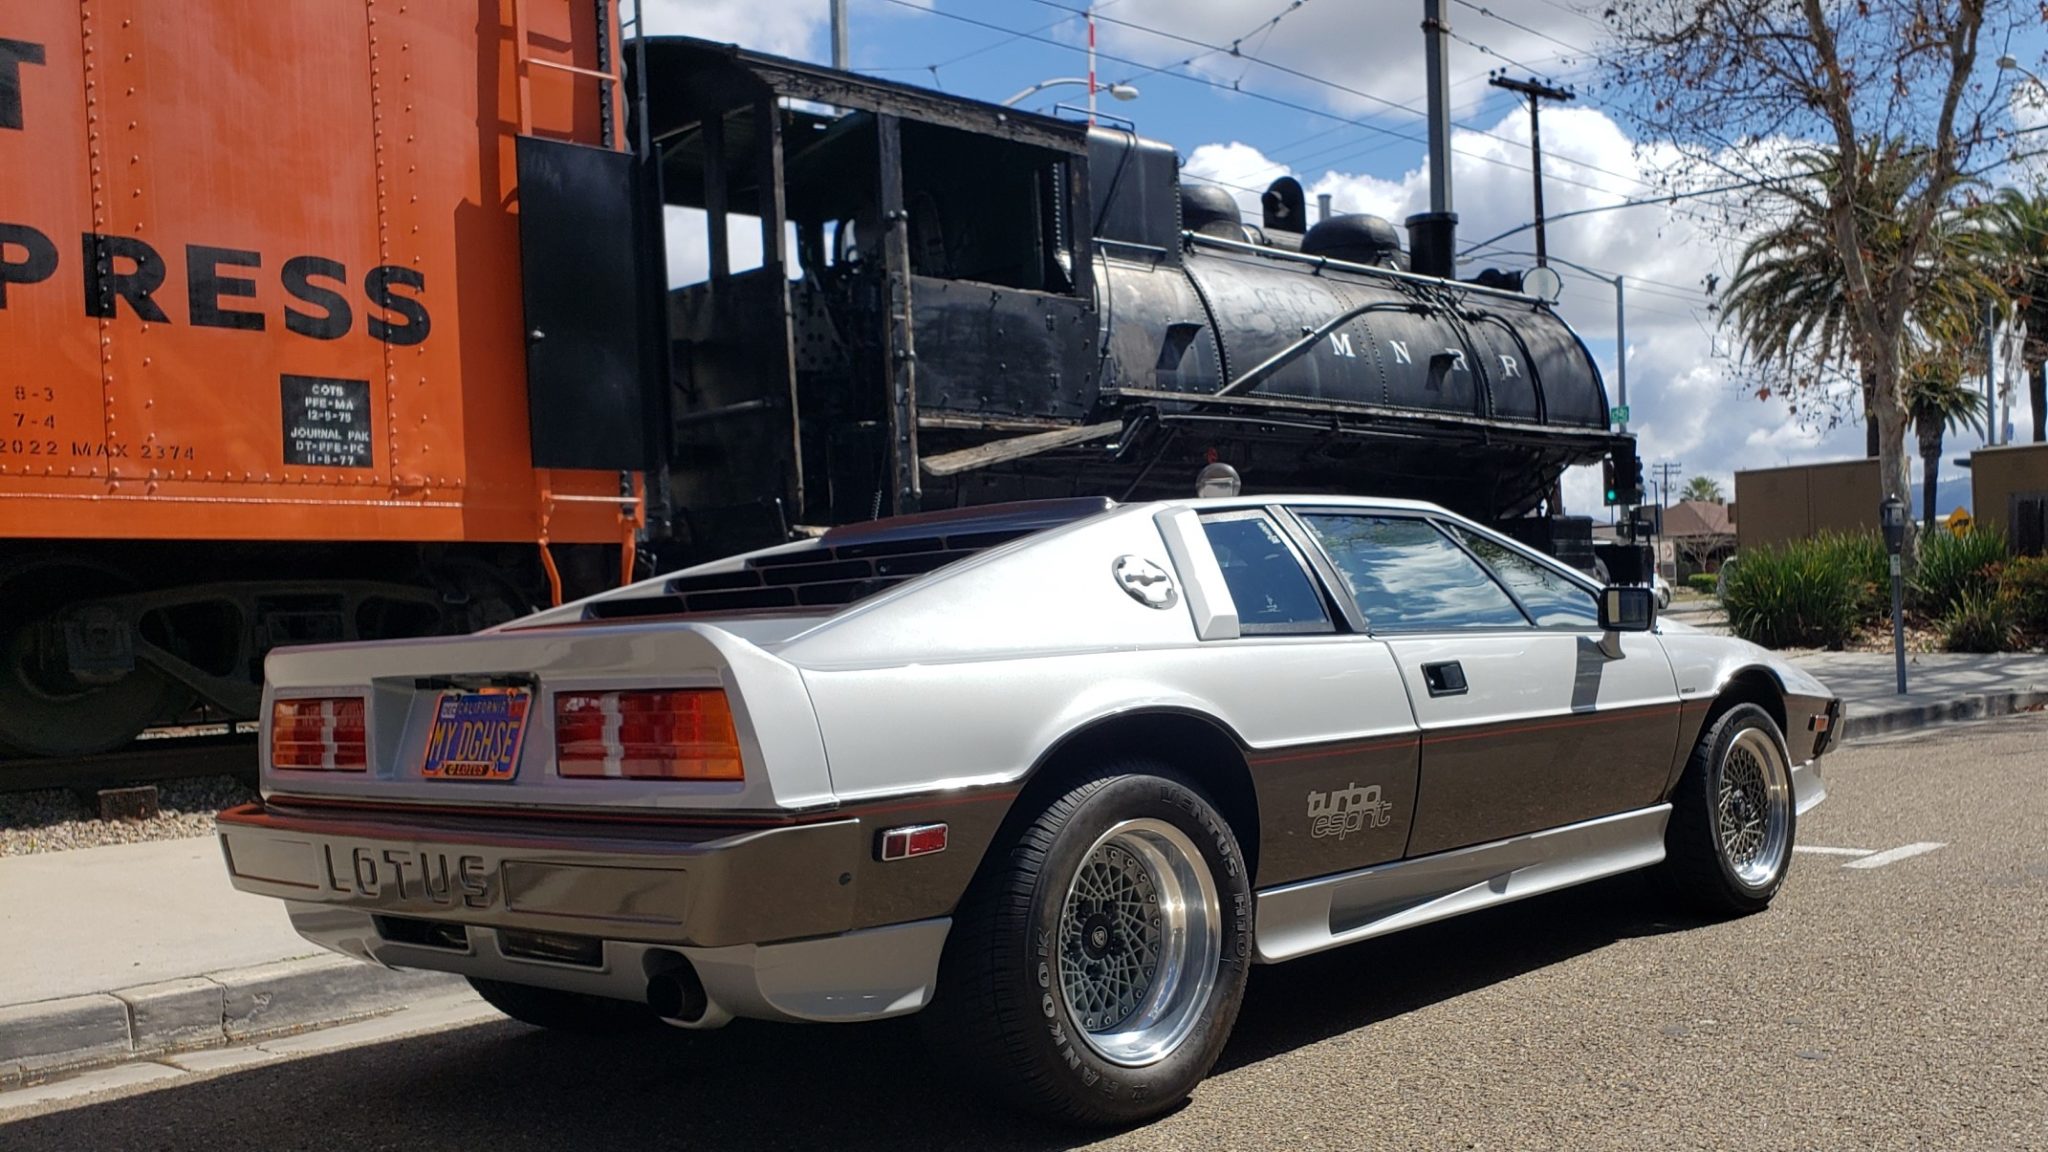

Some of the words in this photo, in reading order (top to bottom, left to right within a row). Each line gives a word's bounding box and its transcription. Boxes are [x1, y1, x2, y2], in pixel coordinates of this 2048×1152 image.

[0, 222, 431, 346] PRESS
[72, 442, 128, 458] MAX
[141, 444, 194, 460] 2374
[290, 427, 342, 440] JOURNAL
[457, 700, 507, 715] CALIFORNIA
[428, 720, 458, 762] MY
[1307, 782, 1382, 818] turbo
[1159, 785, 1239, 878] VENTUS
[1311, 801, 1393, 841] esprit
[324, 843, 492, 909] LOTUS
